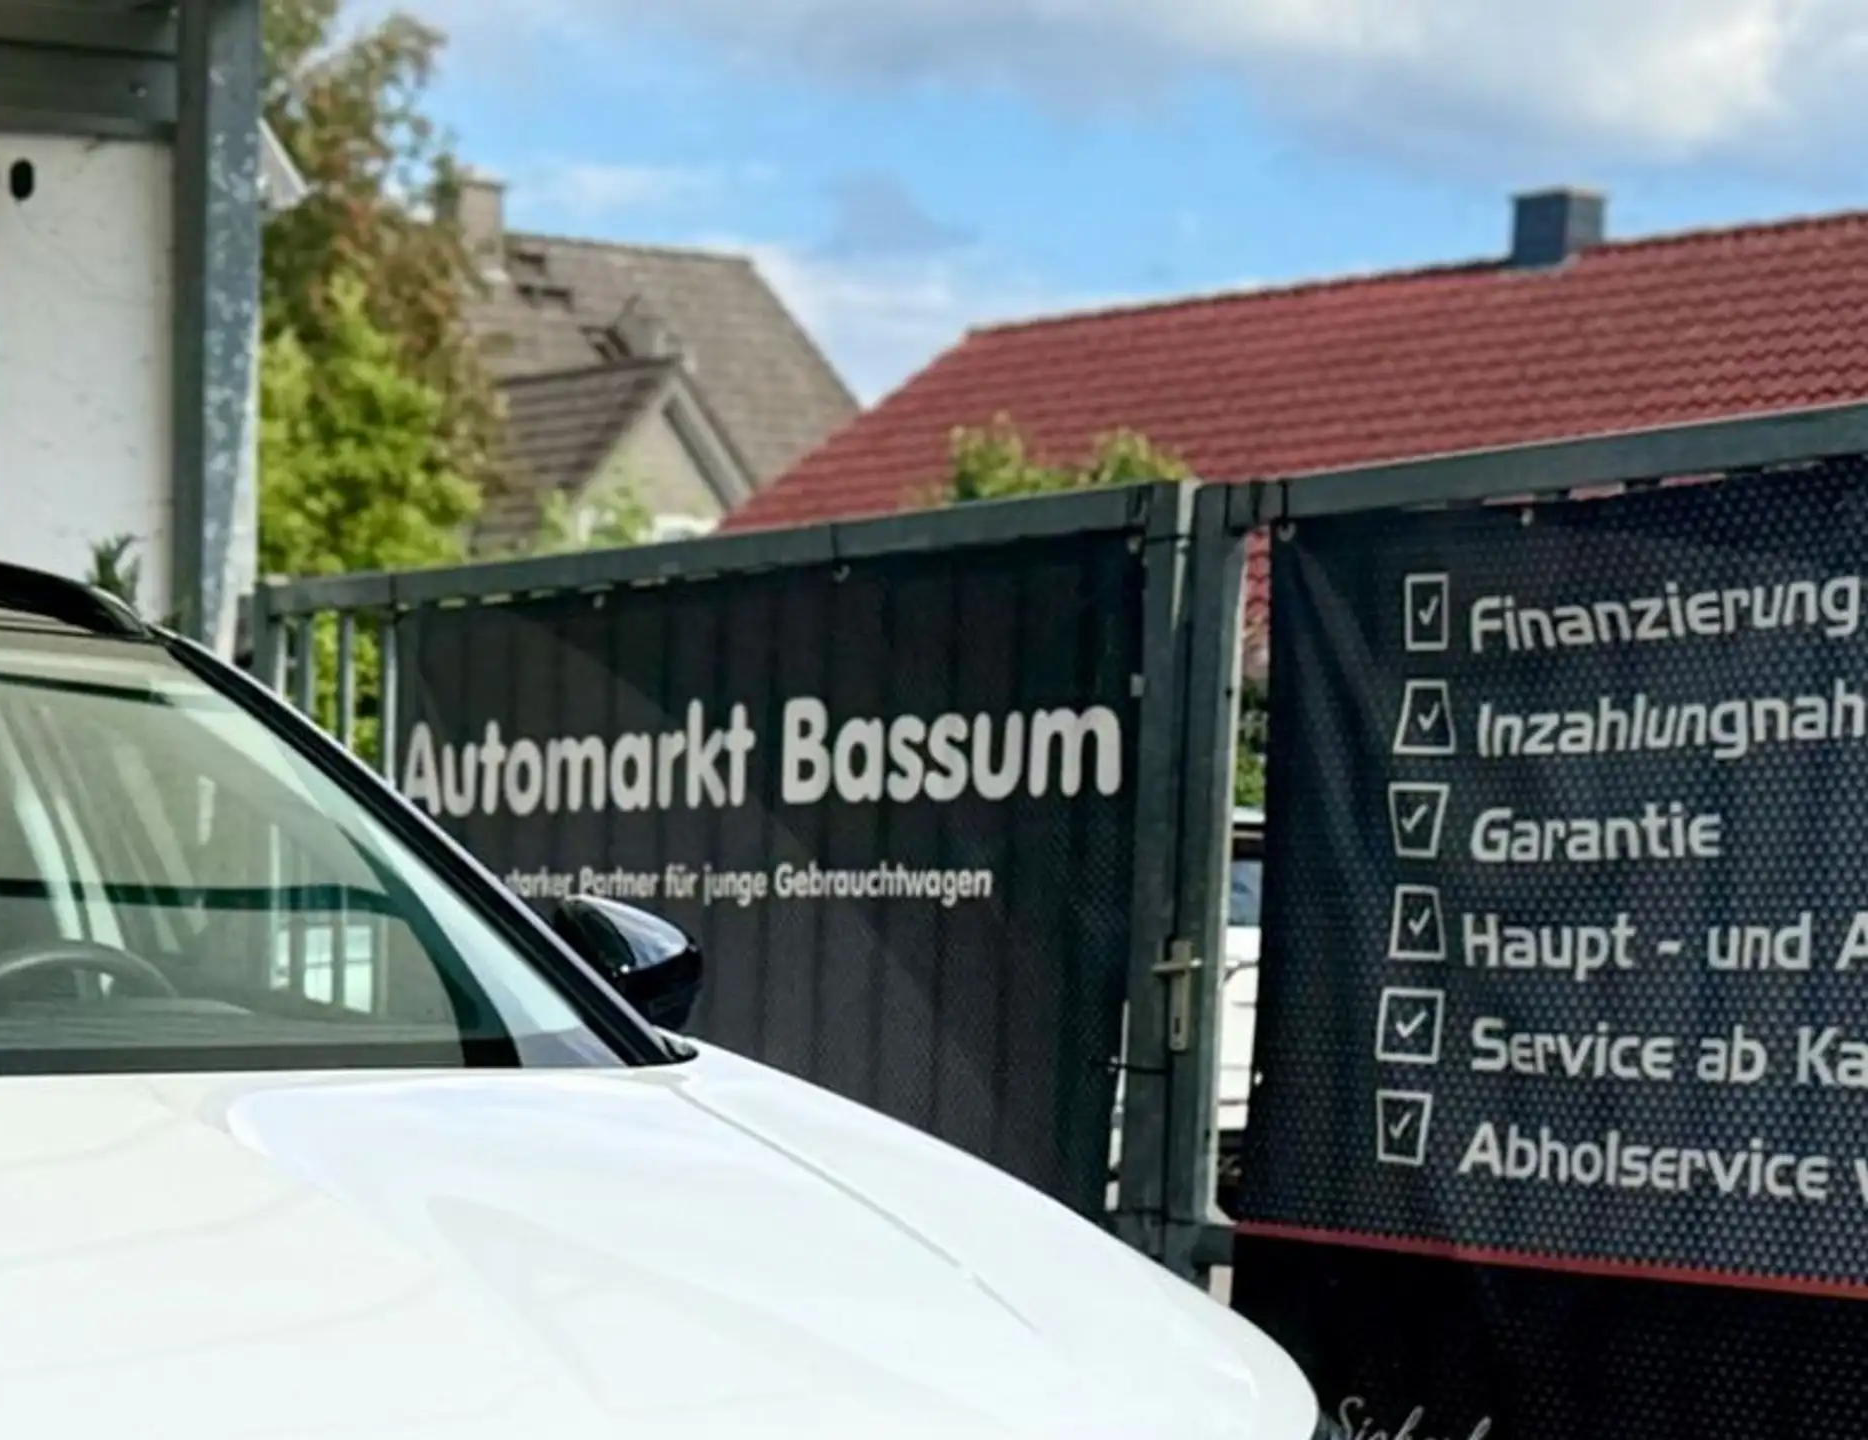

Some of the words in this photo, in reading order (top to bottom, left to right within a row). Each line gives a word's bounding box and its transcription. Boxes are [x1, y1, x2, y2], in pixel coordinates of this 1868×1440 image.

[1470, 575, 1862, 653] Finanzierung
[1476, 678, 1868, 760] Inzahlungnah
[403, 699, 756, 817] Automarkt
[781, 696, 1123, 804] Bassum
[1470, 802, 1723, 863] Garantie
[579, 865, 659, 899] Partner
[664, 862, 700, 898] für
[703, 862, 768, 907] junge
[774, 859, 993, 908] Gebrauchtwagen
[1462, 911, 1635, 981] Haupt
[1706, 910, 1813, 971] und
[1470, 1016, 1676, 1081] Service
[1696, 1023, 1768, 1084] ab
[1796, 1026, 1868, 1087] Ka
[1458, 1121, 1831, 1199] Abholservice
